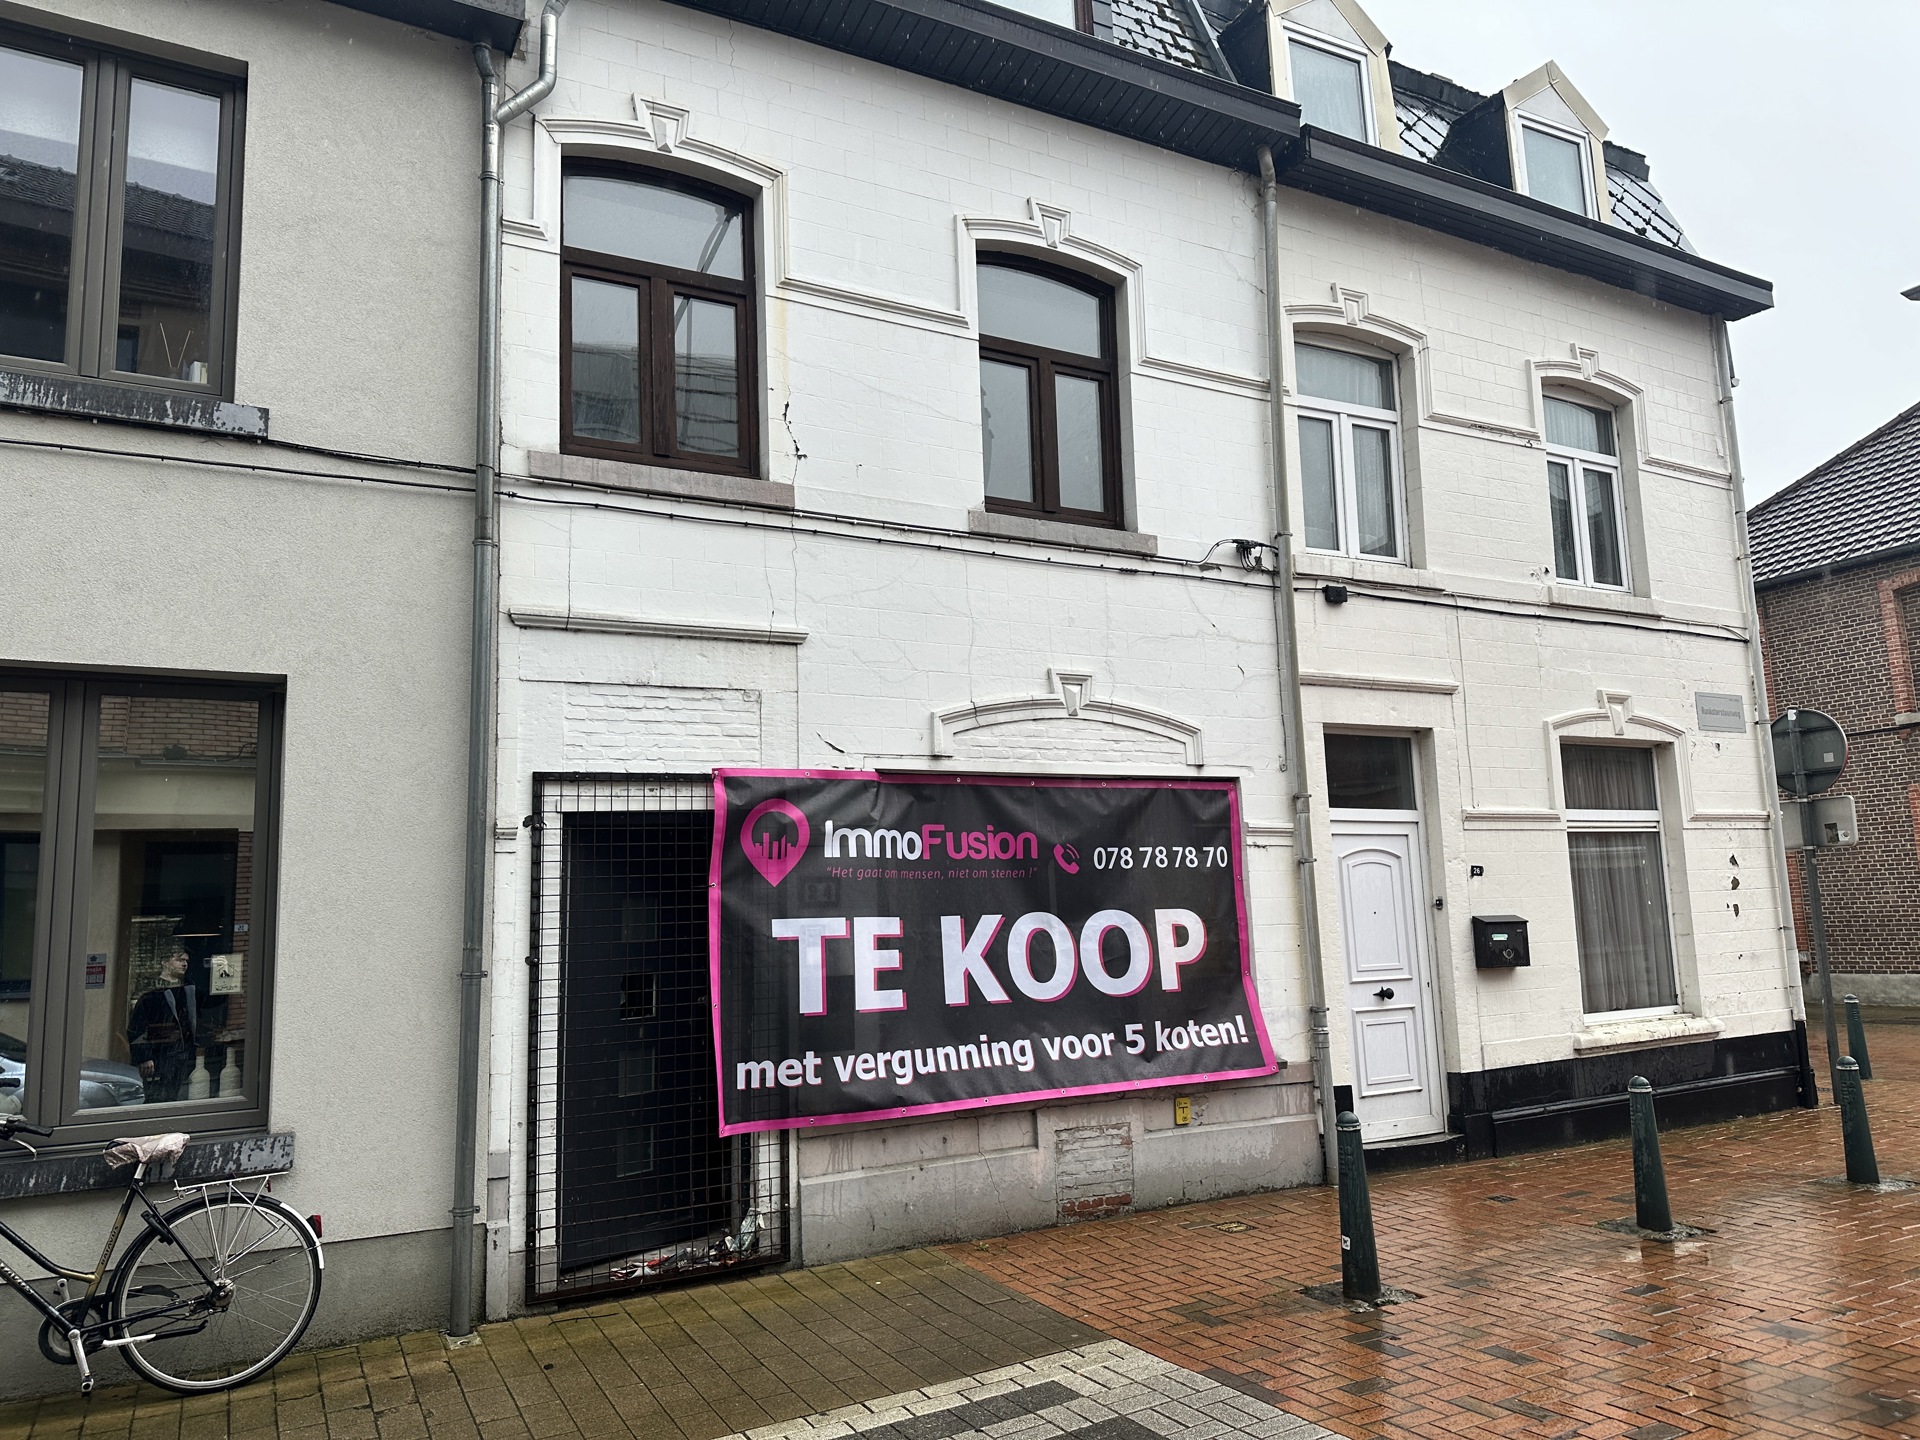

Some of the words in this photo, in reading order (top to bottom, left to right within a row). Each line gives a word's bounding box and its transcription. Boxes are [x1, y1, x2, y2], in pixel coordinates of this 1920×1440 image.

[824, 820, 1038, 861] ImmoFusion
[1093, 847, 1134, 870] 078
[1139, 846, 1168, 868] 78
[1172, 846, 1199, 868] 78
[1203, 846, 1228, 868] 70
[857, 867, 882, 880] gaat
[884, 869, 899, 879] om
[900, 869, 944, 880] mensen,
[948, 867, 969, 879] niet
[972, 869, 988, 879] om
[990, 868, 1025, 879] stenen
[771, 917, 907, 1015] TE
[940, 909, 1207, 1007] KOOP
[737, 1050, 823, 1090] met
[833, 1034, 1035, 1085] vergunning
[1042, 1030, 1116, 1062] voor
[1124, 1023, 1146, 1055] 5
[1154, 1015, 1249, 1052] koten!
